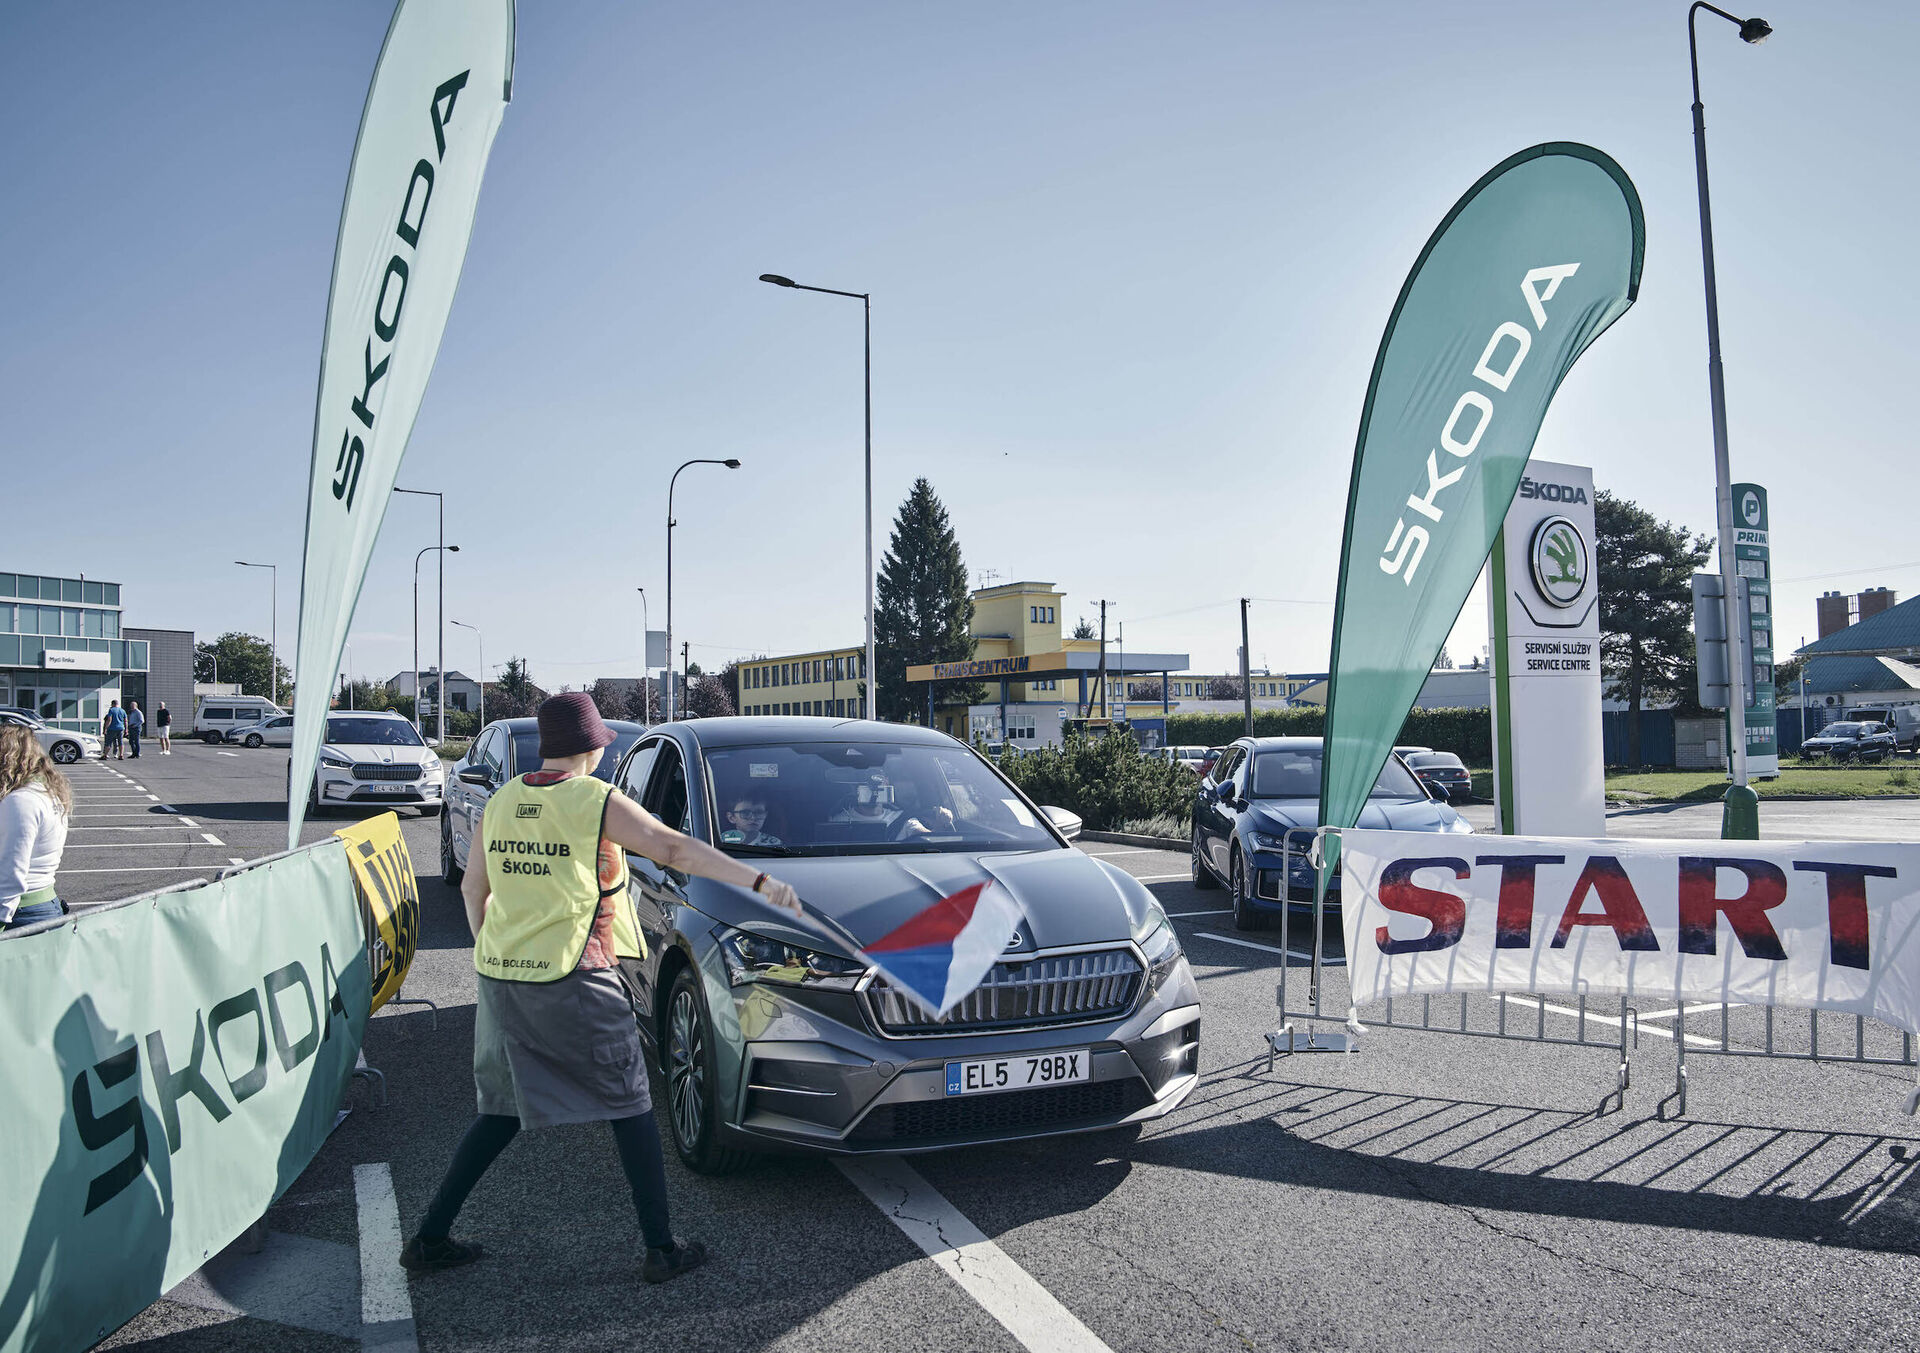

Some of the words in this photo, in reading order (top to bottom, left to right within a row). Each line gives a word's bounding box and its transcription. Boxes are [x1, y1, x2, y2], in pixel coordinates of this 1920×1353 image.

[1520, 476, 1588, 505] ŠKODA
[1525, 641, 1561, 655] SERVISNÍ
[1563, 641, 1591, 655] SLUŽBY
[934, 656, 1030, 678] TRANSCENTRUM
[1527, 659, 1560, 671] SERVICE
[1561, 659, 1591, 671] CENTRE
[488, 839, 571, 857] AUTOKLUB
[502, 857, 552, 876] ŠKODA
[1375, 854, 1898, 971] START
[502, 959, 551, 970] BOLESLAV
[966, 1061, 1009, 1090] EL5
[1026, 1054, 1079, 1084] 79BX
[948, 1082, 960, 1092] CZ
